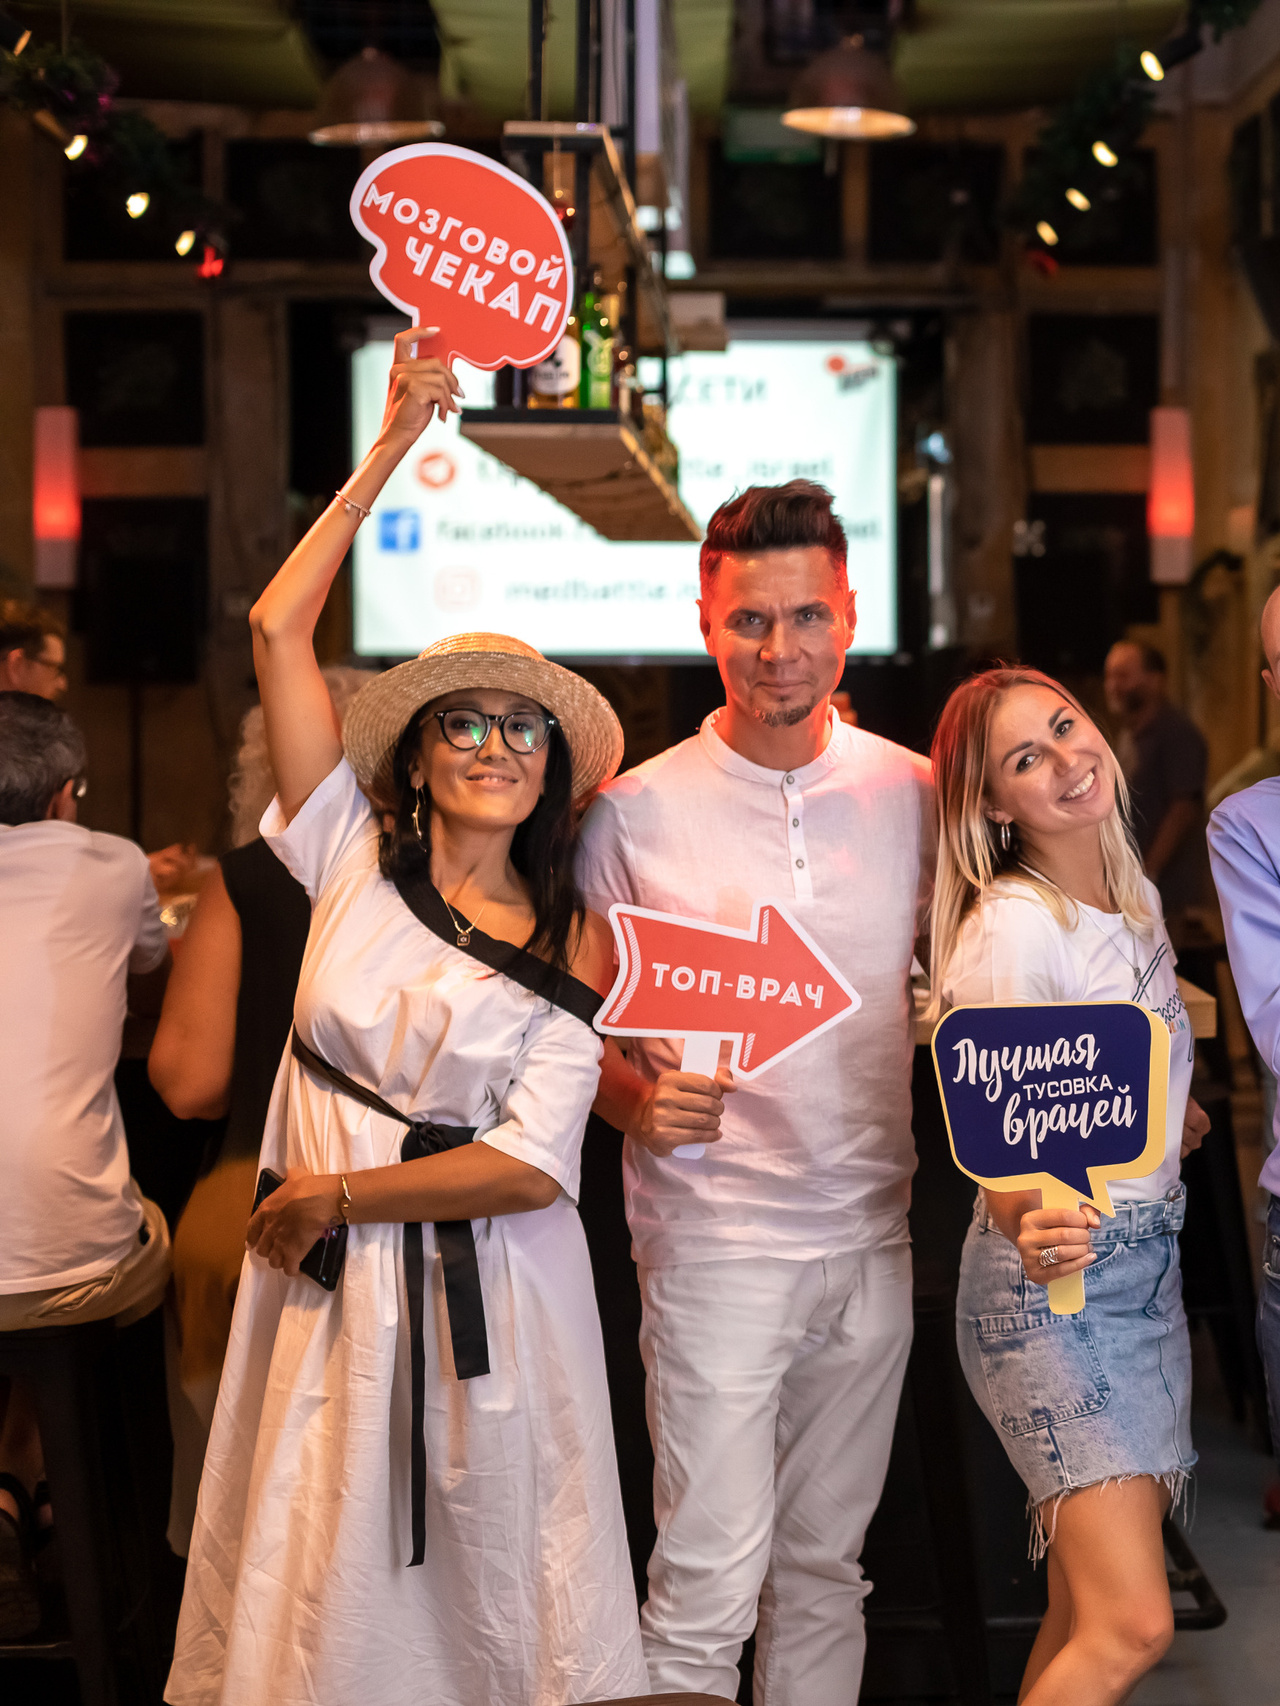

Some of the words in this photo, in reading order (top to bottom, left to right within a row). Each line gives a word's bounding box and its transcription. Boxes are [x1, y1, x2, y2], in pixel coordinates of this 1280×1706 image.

[363, 183, 564, 289] МОЗГОВОЙ
[405, 236, 562, 333] ЧЕКАП
[652, 962, 824, 1009] ТОП-ВРАЧ
[952, 1033, 1100, 1102] Лучшая
[1023, 1074, 1113, 1100] ТУСОВКА
[1003, 1084, 1137, 1159] врачей
